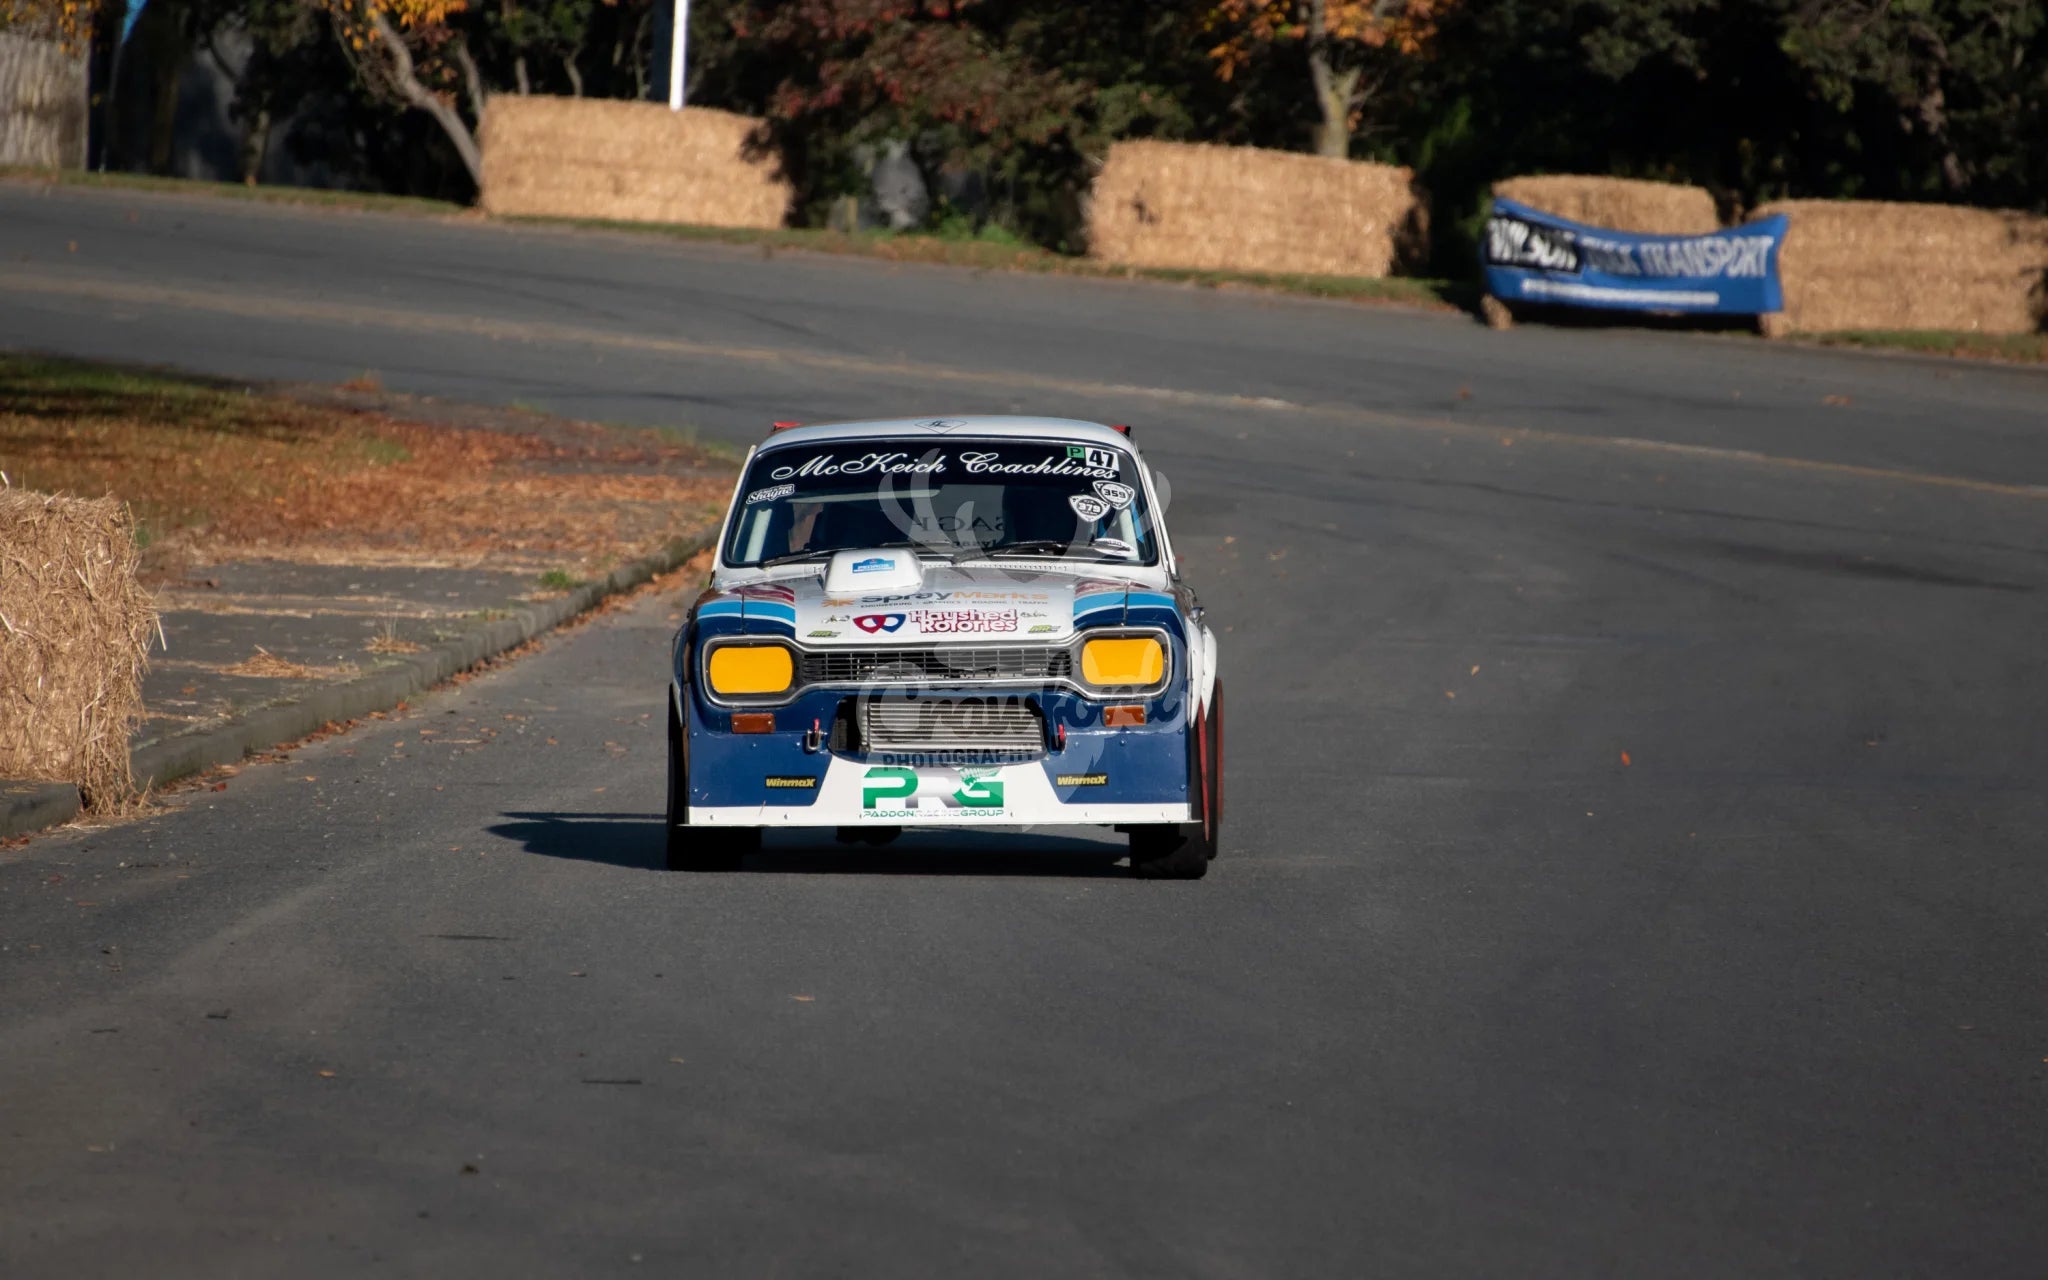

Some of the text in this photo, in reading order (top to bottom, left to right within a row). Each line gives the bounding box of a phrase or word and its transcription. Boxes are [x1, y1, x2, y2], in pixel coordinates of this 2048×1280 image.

[1640, 234, 1774, 279] TRANSPORT
[1069, 447, 1082, 457] P
[1089, 449, 1115, 468] 47
[771, 451, 1117, 480] McKeich Coachlines
[1103, 488, 1127, 499] 359
[1078, 501, 1101, 513] 379
